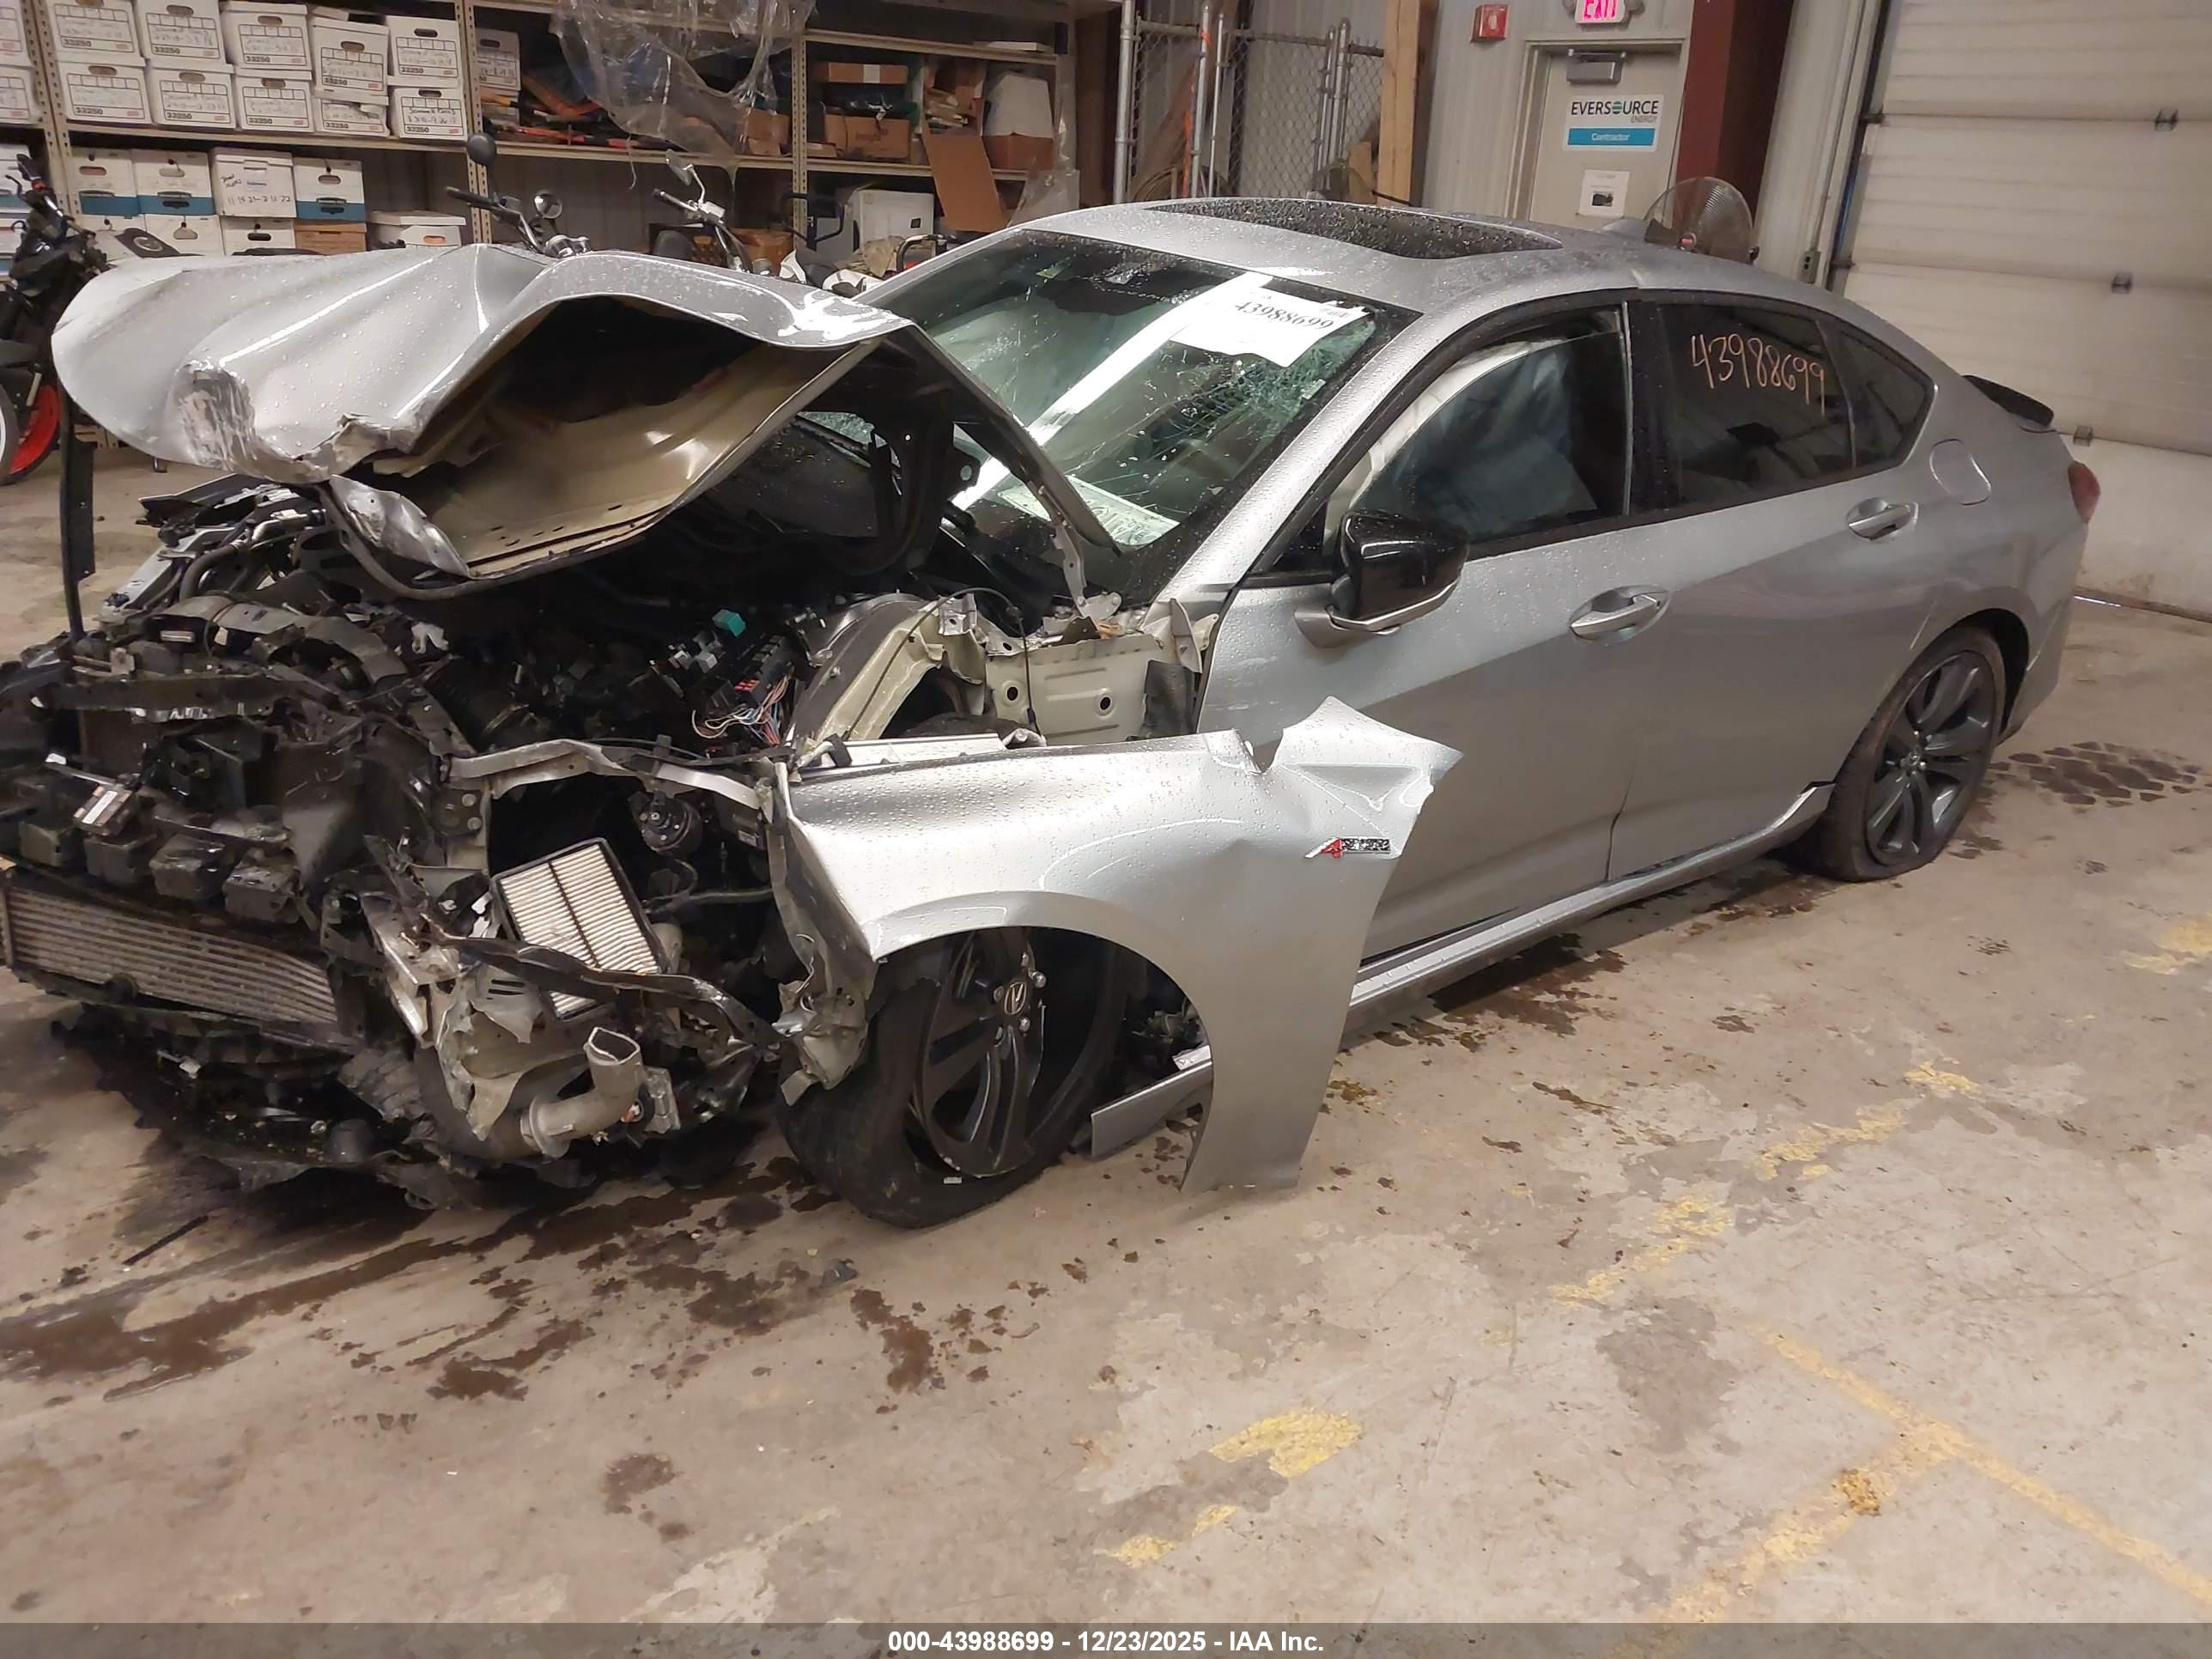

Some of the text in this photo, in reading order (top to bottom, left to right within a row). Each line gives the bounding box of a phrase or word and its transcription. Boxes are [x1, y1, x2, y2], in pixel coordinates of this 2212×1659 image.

[1583, 0, 1618, 19] EXIT
[1571, 100, 1659, 115] EVERSOURCE
[1235, 301, 1334, 329] 43988699
[1691, 333, 1825, 416] 43988699
